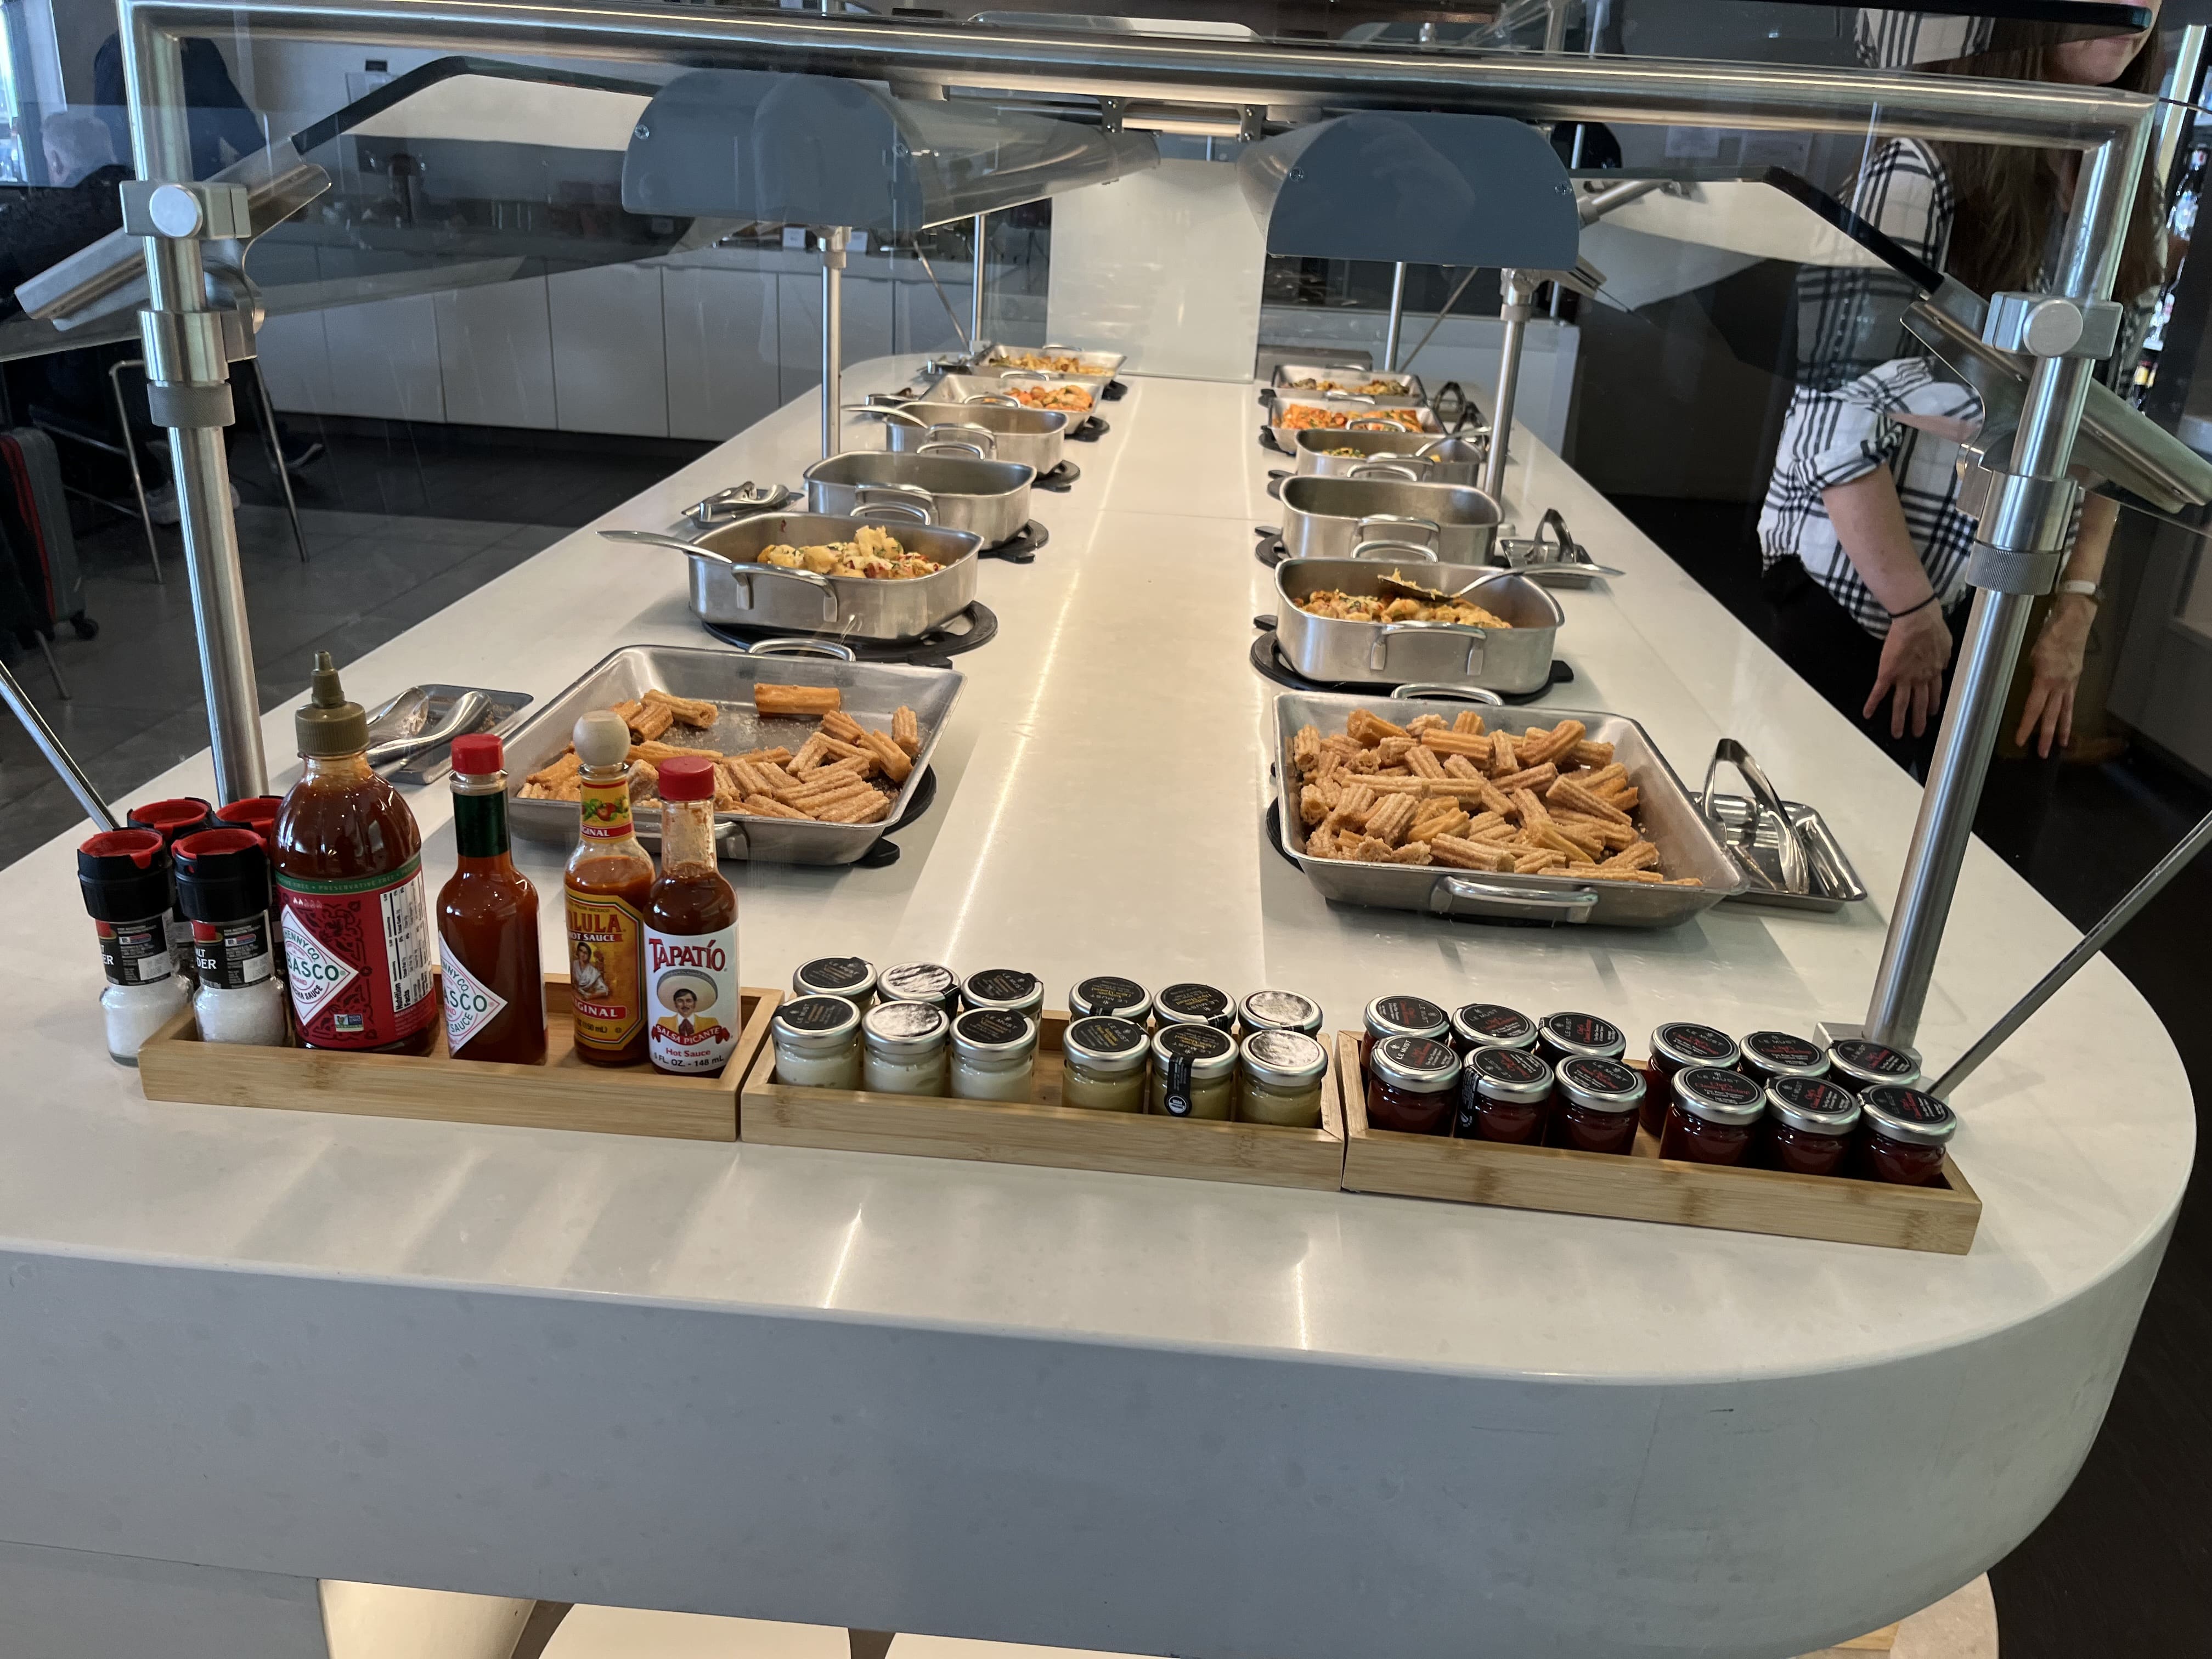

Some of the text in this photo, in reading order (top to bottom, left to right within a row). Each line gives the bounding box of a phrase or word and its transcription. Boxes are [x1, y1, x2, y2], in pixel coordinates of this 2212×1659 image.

[441, 962, 459, 979] NNY
[305, 984, 323, 1000] SAUCE
[451, 1012, 473, 1033] SAUCE
[656, 1025, 721, 1045] SALSA PICANTE
[665, 1047, 712, 1058] Hot Sauce
[1400, 1040, 1412, 1054] MUST
[694, 1059, 709, 1067] 148
[712, 1055, 724, 1064] mL
[1712, 1076, 1740, 1084] MUST
